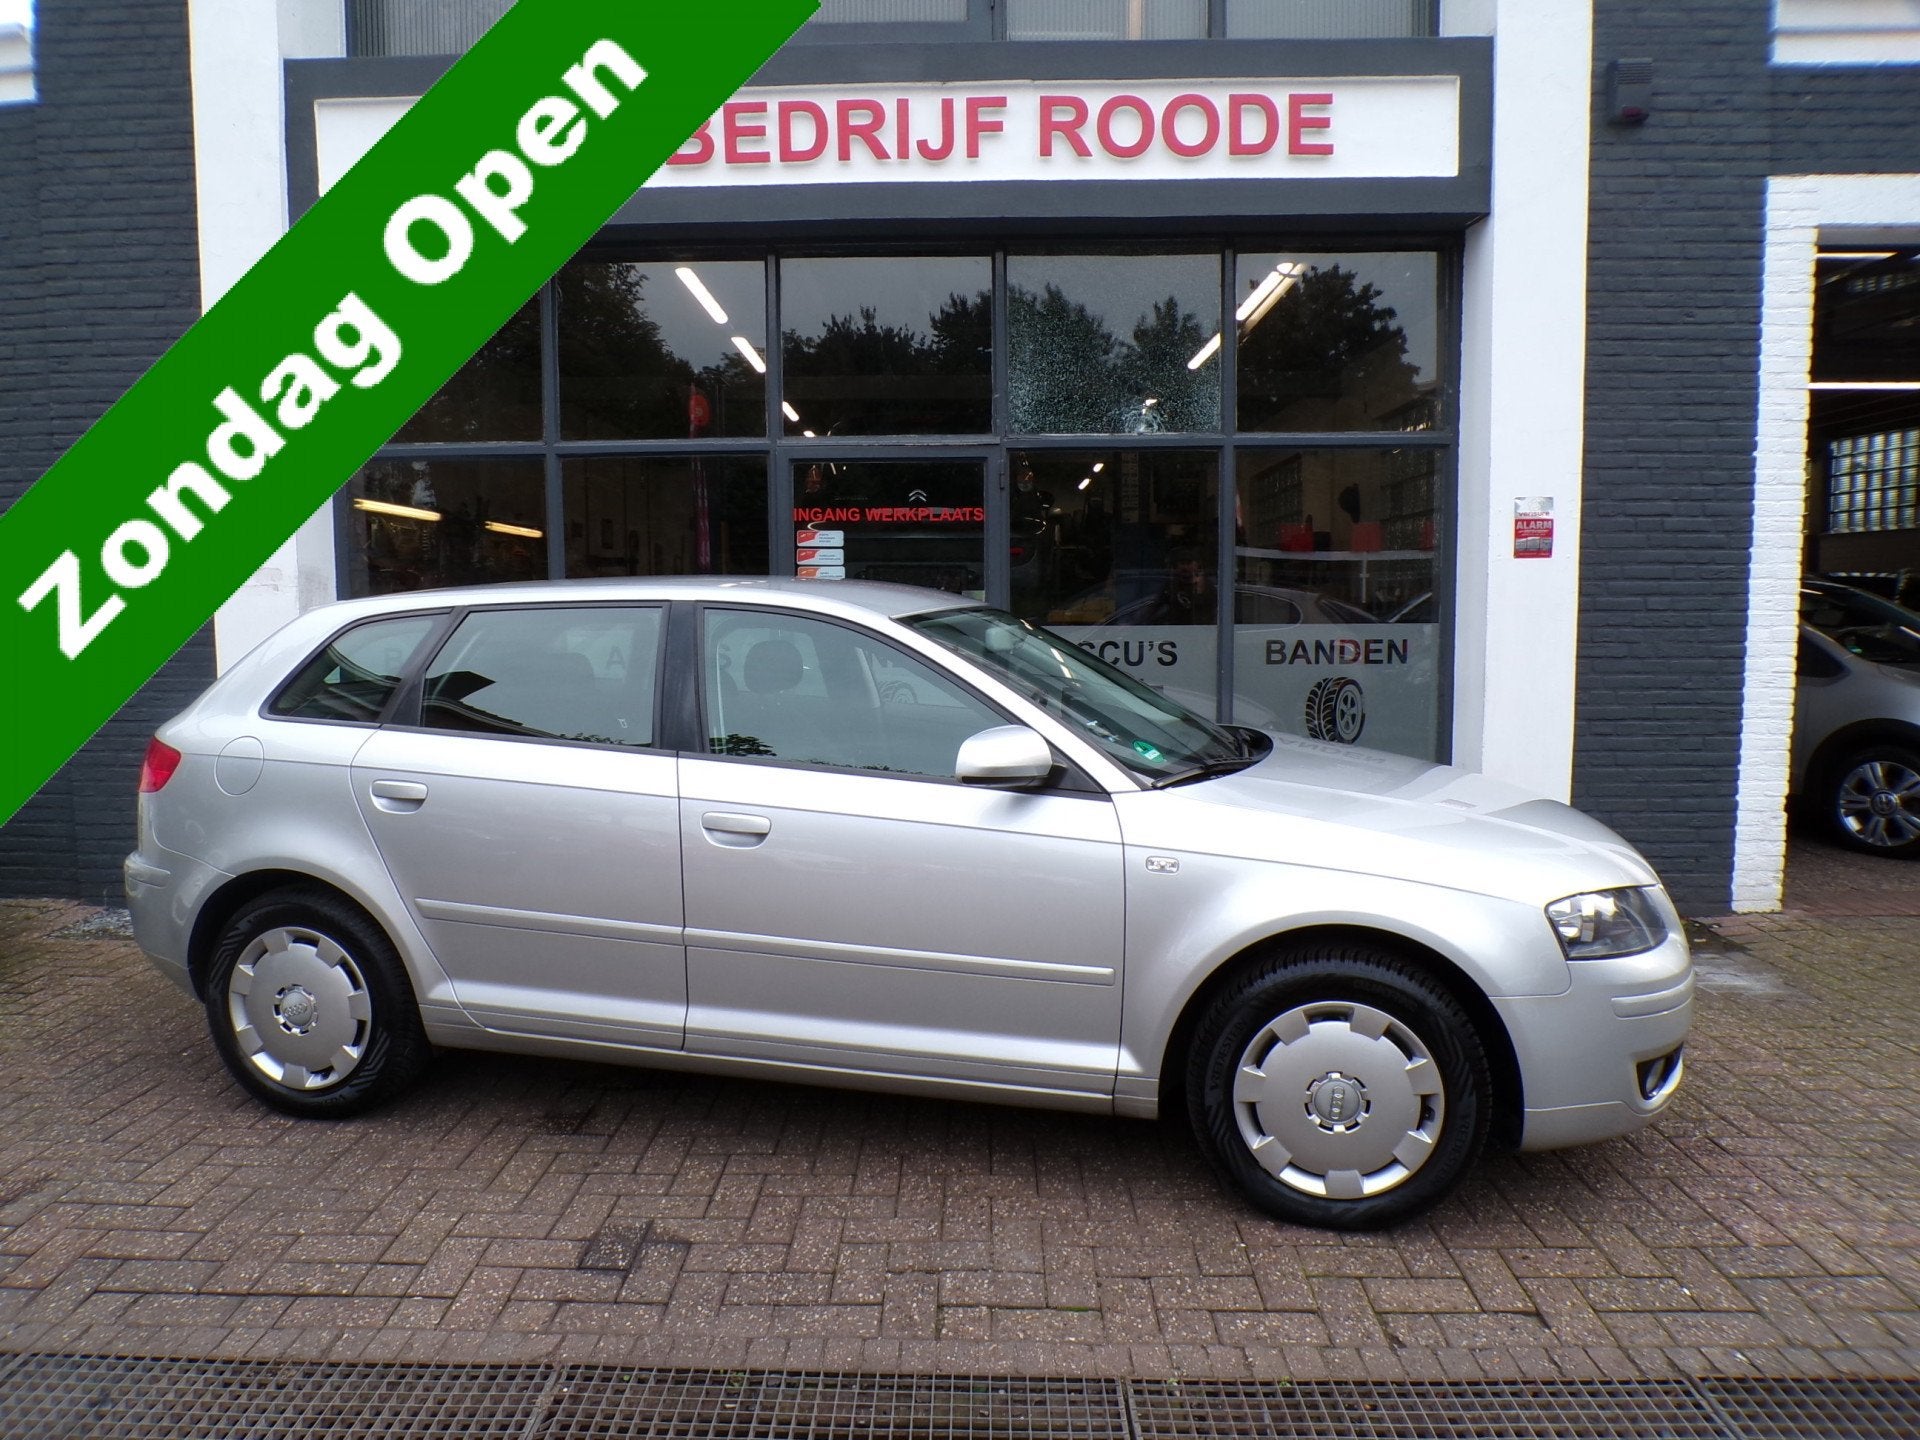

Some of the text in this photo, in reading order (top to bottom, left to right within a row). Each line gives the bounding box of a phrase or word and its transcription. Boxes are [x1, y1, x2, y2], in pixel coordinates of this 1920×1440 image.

[1039, 94, 1335, 158] ROODE
[794, 507, 985, 522] INGANG WERKPLAATS
[1516, 520, 1552, 530] ALARM
[1078, 640, 1178, 667] CU'S
[1265, 638, 1408, 665] BANDEN
